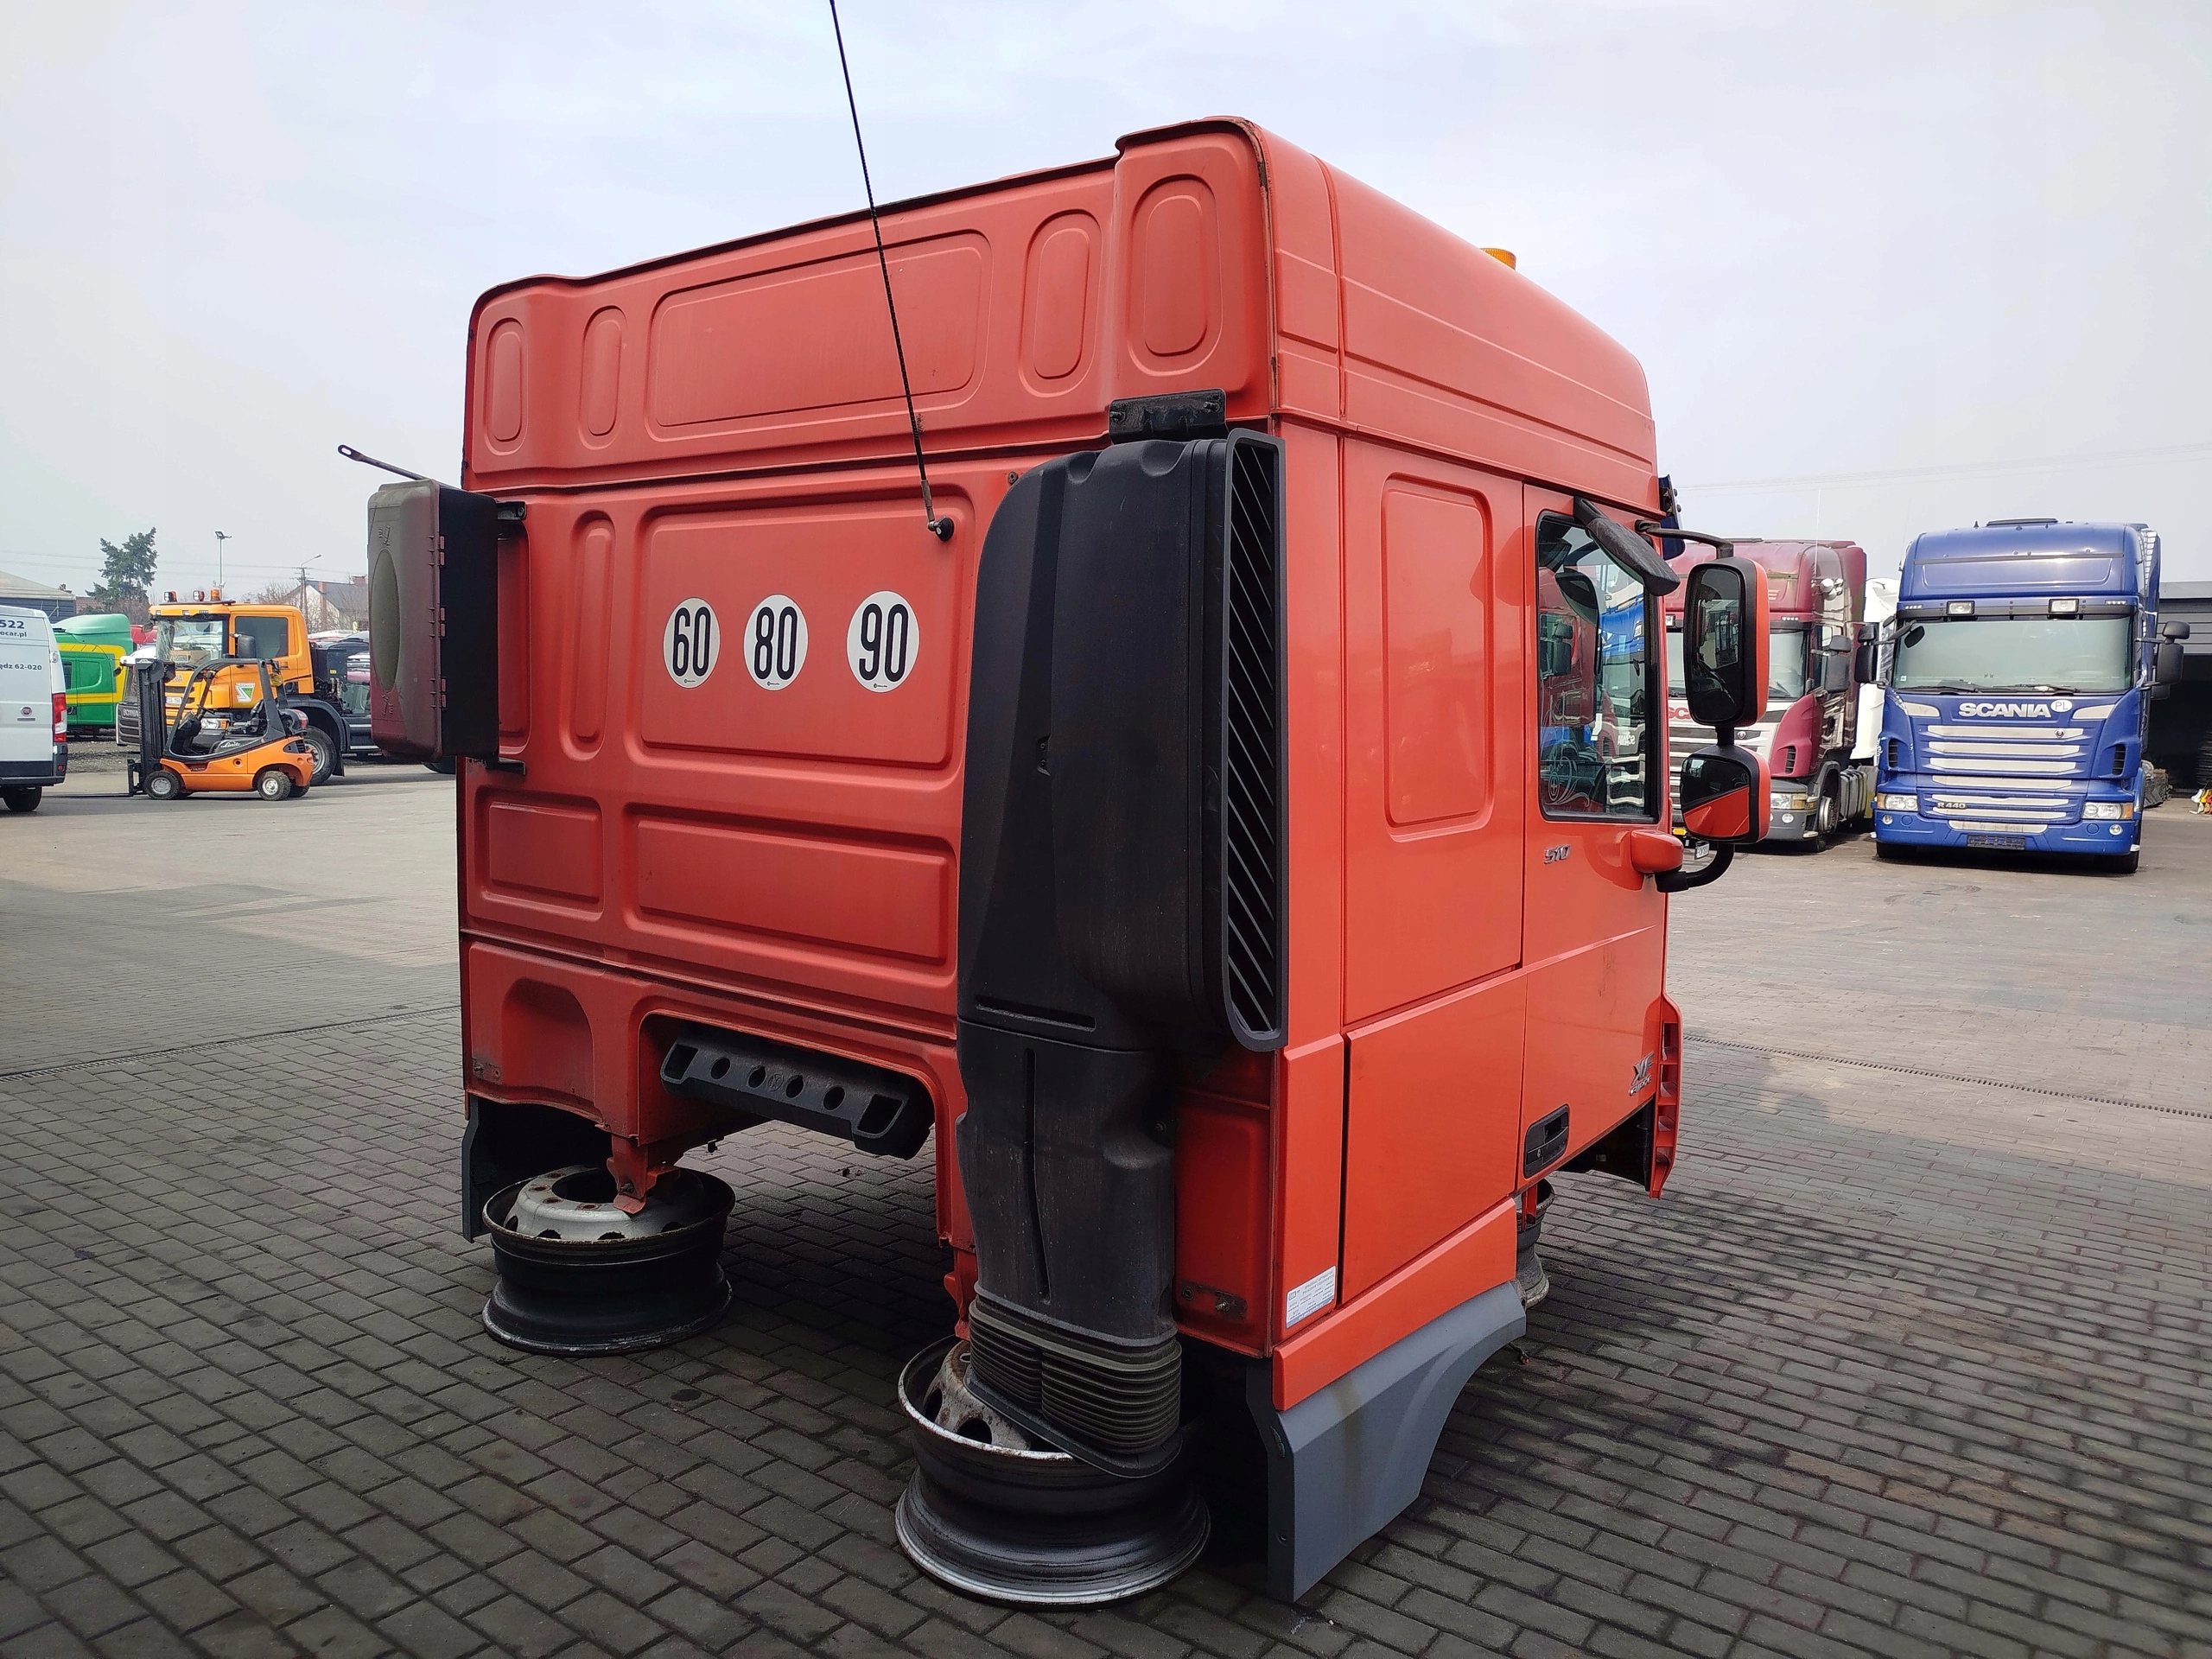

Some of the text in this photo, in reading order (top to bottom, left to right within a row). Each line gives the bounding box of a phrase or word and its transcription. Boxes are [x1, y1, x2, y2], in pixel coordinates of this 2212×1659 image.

[0, 620, 25, 629] 522
[671, 606, 711, 677] 60
[753, 606, 798, 680] 80
[858, 603, 909, 683] 90
[1958, 702, 2051, 718] SCANIA
[2055, 702, 2069, 711] PL
[1544, 844, 1571, 864] 510
